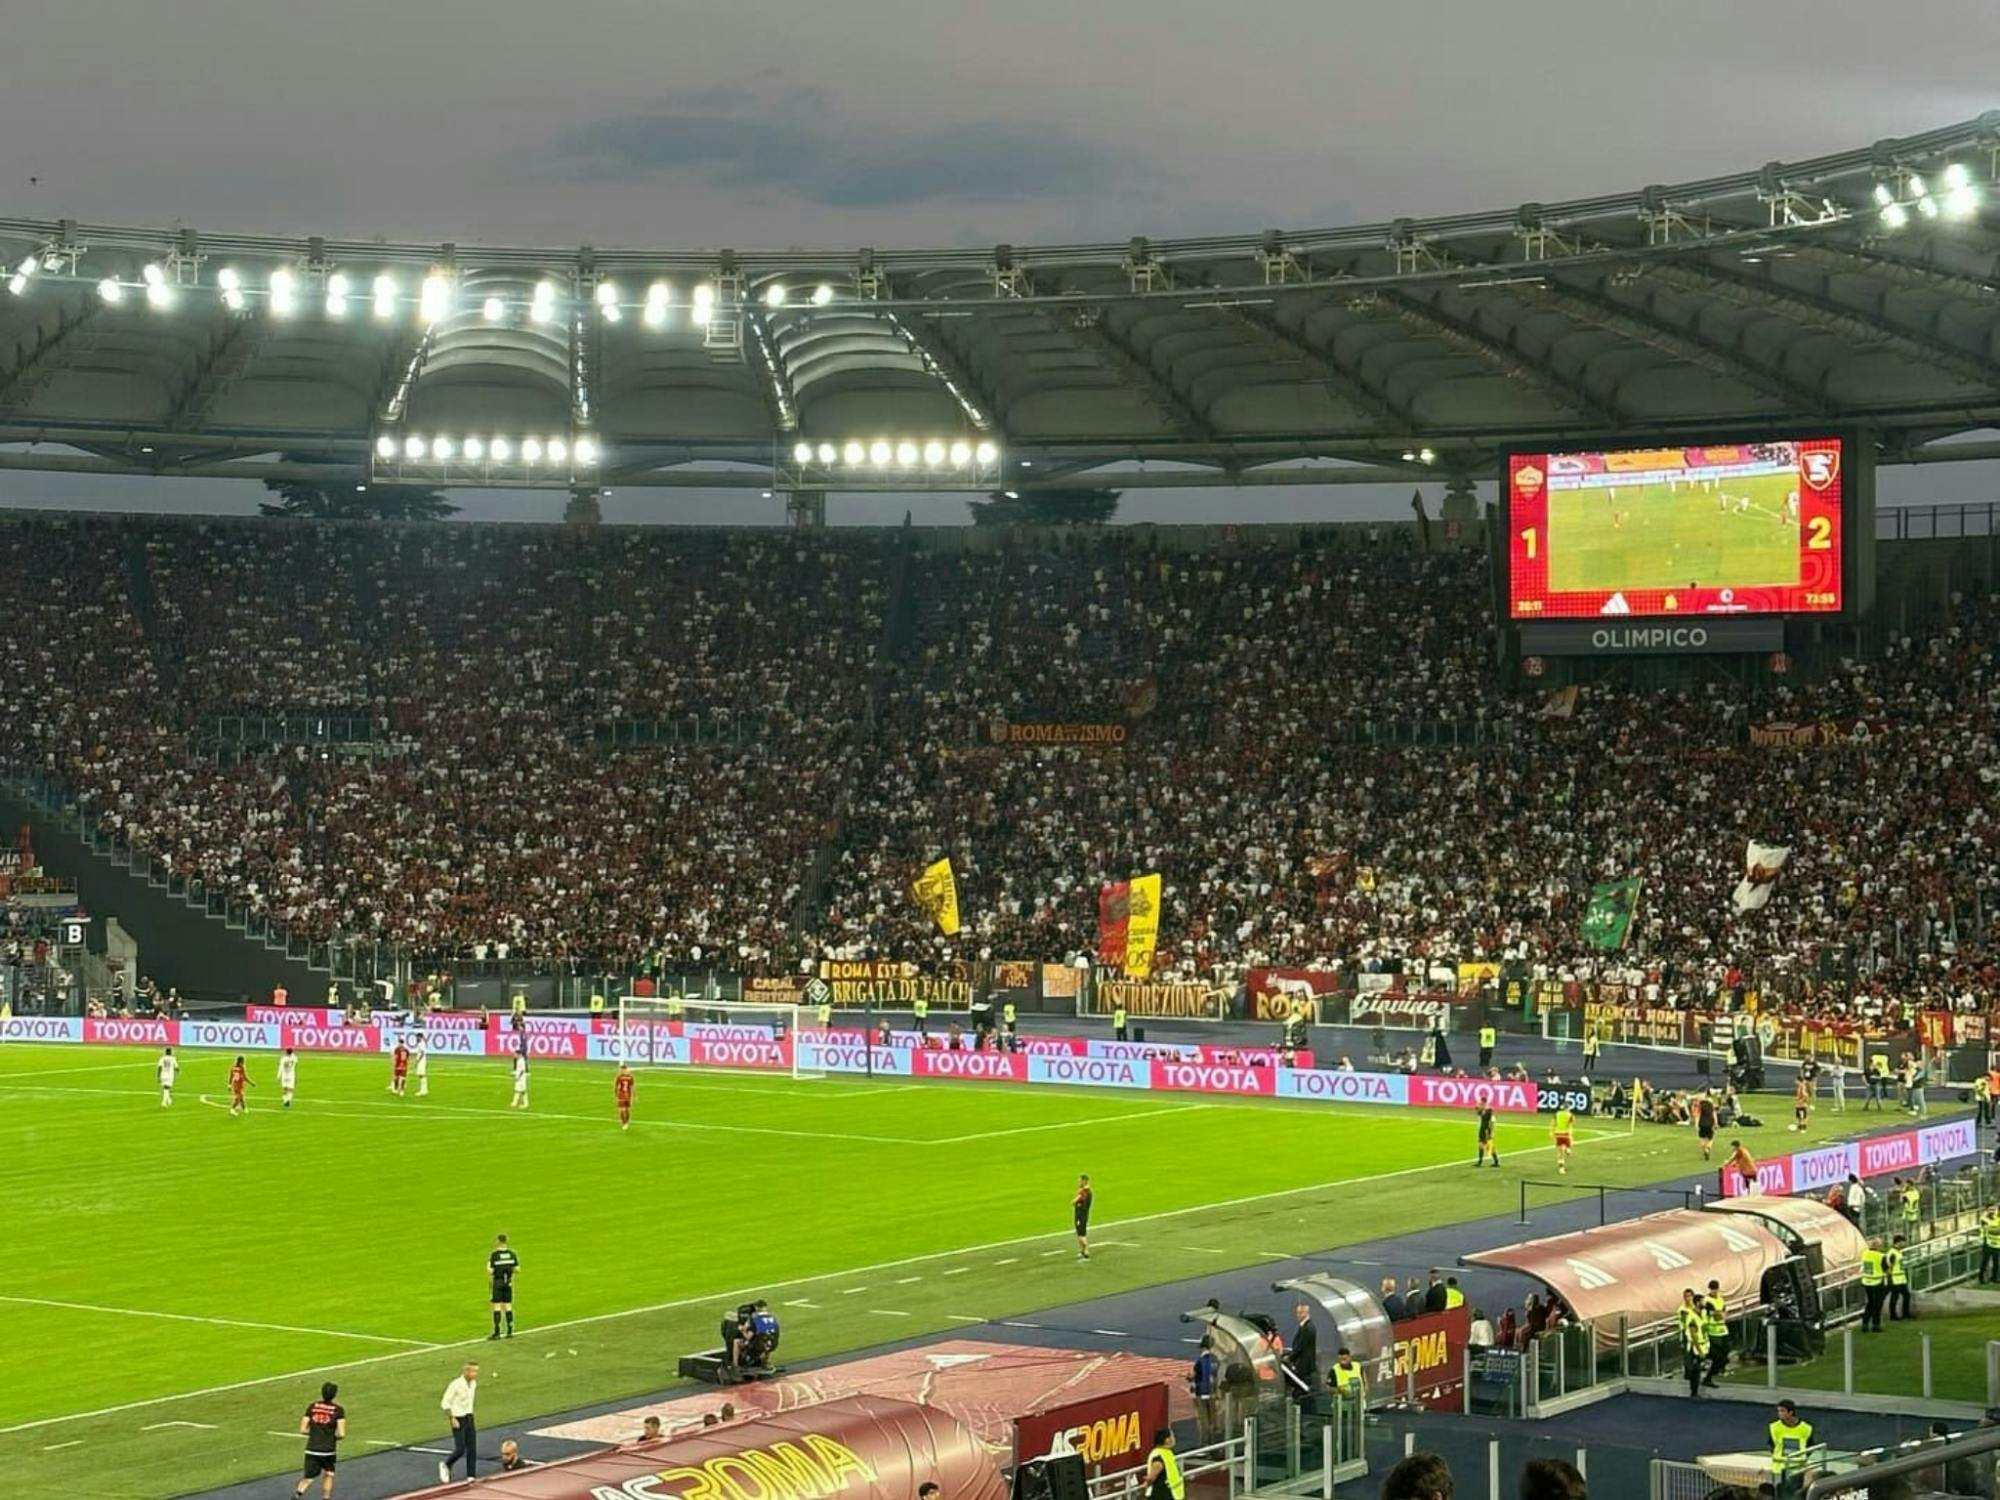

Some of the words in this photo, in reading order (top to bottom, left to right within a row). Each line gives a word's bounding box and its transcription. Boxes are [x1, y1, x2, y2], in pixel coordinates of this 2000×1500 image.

[1521, 527, 1537, 558] 1
[1808, 517, 1832, 549] 2
[1591, 627, 1708, 648] OLIMPICO
[68, 924, 82, 943] B
[832, 962, 872, 978] ROMA
[832, 981, 896, 1003] BRIGATA
[93, 1022, 168, 1041] TOYOTA
[424, 1016, 482, 1030] TOYOT
[521, 1020, 578, 1034] OYOTA
[192, 1025, 268, 1045] TOYOTA
[291, 1028, 368, 1048] TOYOTA
[596, 1039, 677, 1059] TOYOTA
[702, 1042, 784, 1065] TOYOTA
[1020, 1040, 1073, 1055] YOTA
[812, 1048, 897, 1070] TOYOTA
[924, 1052, 1014, 1076] TOYOTA
[1043, 1059, 1135, 1084] TOYOTA
[1164, 1066, 1261, 1091] TOYOTA
[1292, 1073, 1391, 1099] TOYOTA
[1421, 1080, 1528, 1107] TOYOTA
[1537, 1090, 1588, 1111] 28:59
[1925, 1127, 1969, 1157] TOYOTA
[1865, 1139, 1912, 1170] TOYOTA
[1801, 1151, 1850, 1184] TOYOTA
[1730, 1164, 1785, 1196] TOOTA
